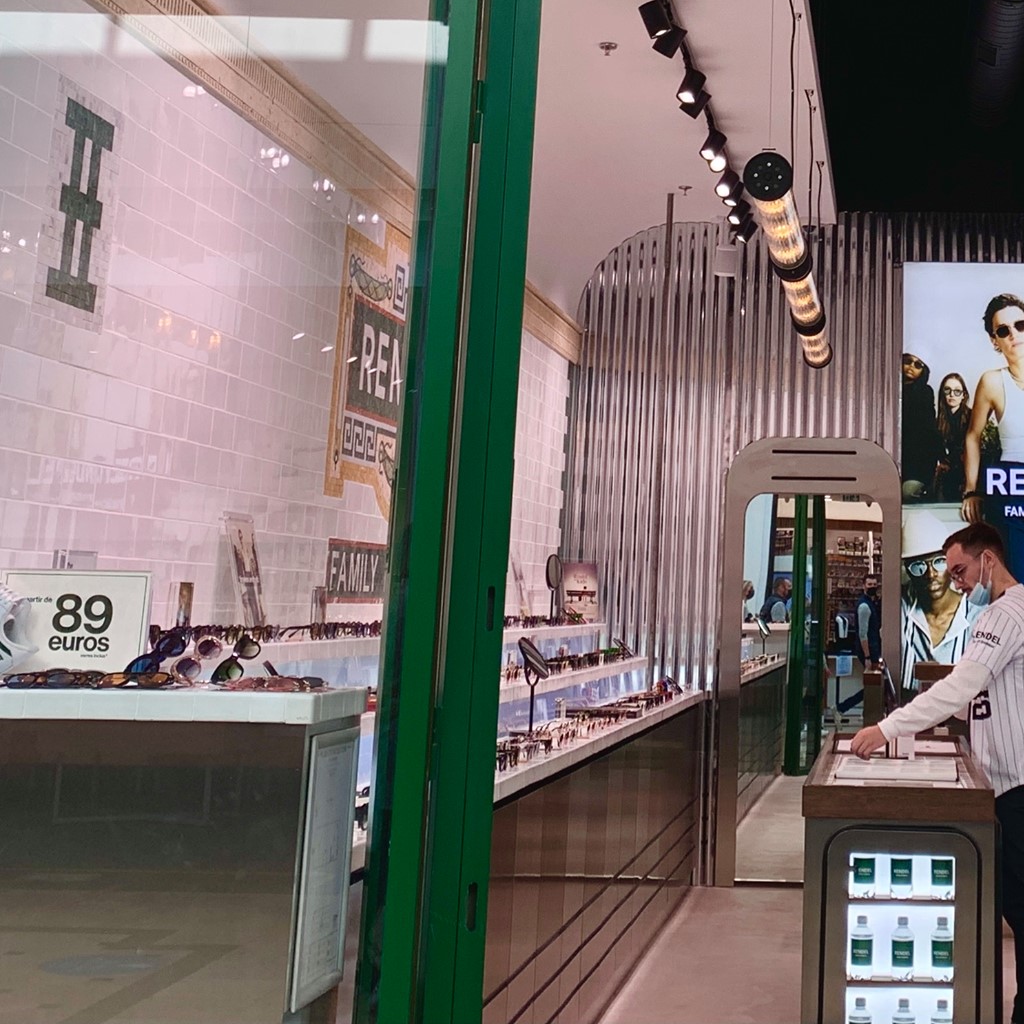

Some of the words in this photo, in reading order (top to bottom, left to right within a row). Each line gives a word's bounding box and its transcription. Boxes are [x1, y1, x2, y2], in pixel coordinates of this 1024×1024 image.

[329, 550, 379, 593] FAMILY
[52, 593, 113, 634] 89
[48, 635, 110, 652] euros
